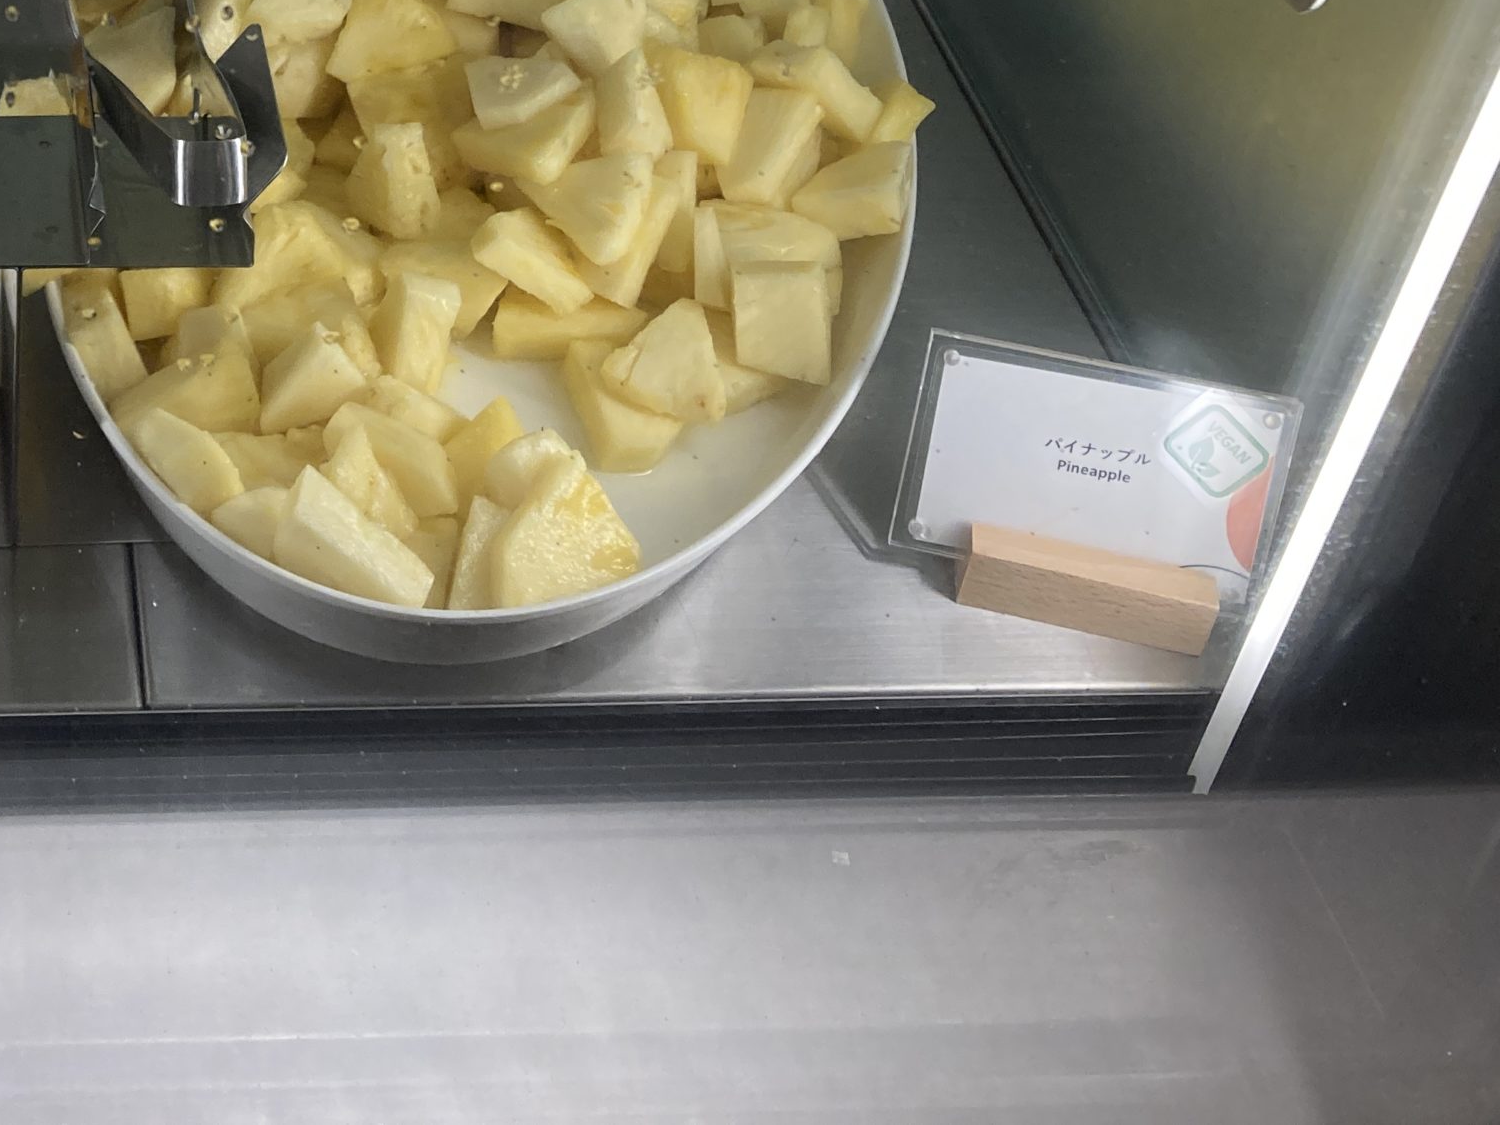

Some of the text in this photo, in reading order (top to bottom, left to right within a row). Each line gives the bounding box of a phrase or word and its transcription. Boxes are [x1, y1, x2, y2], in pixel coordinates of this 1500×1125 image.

[1045, 437, 1151, 465] パイナップル
[1207, 420, 1252, 465] VEGAN
[1057, 459, 1131, 483] Pineapple
